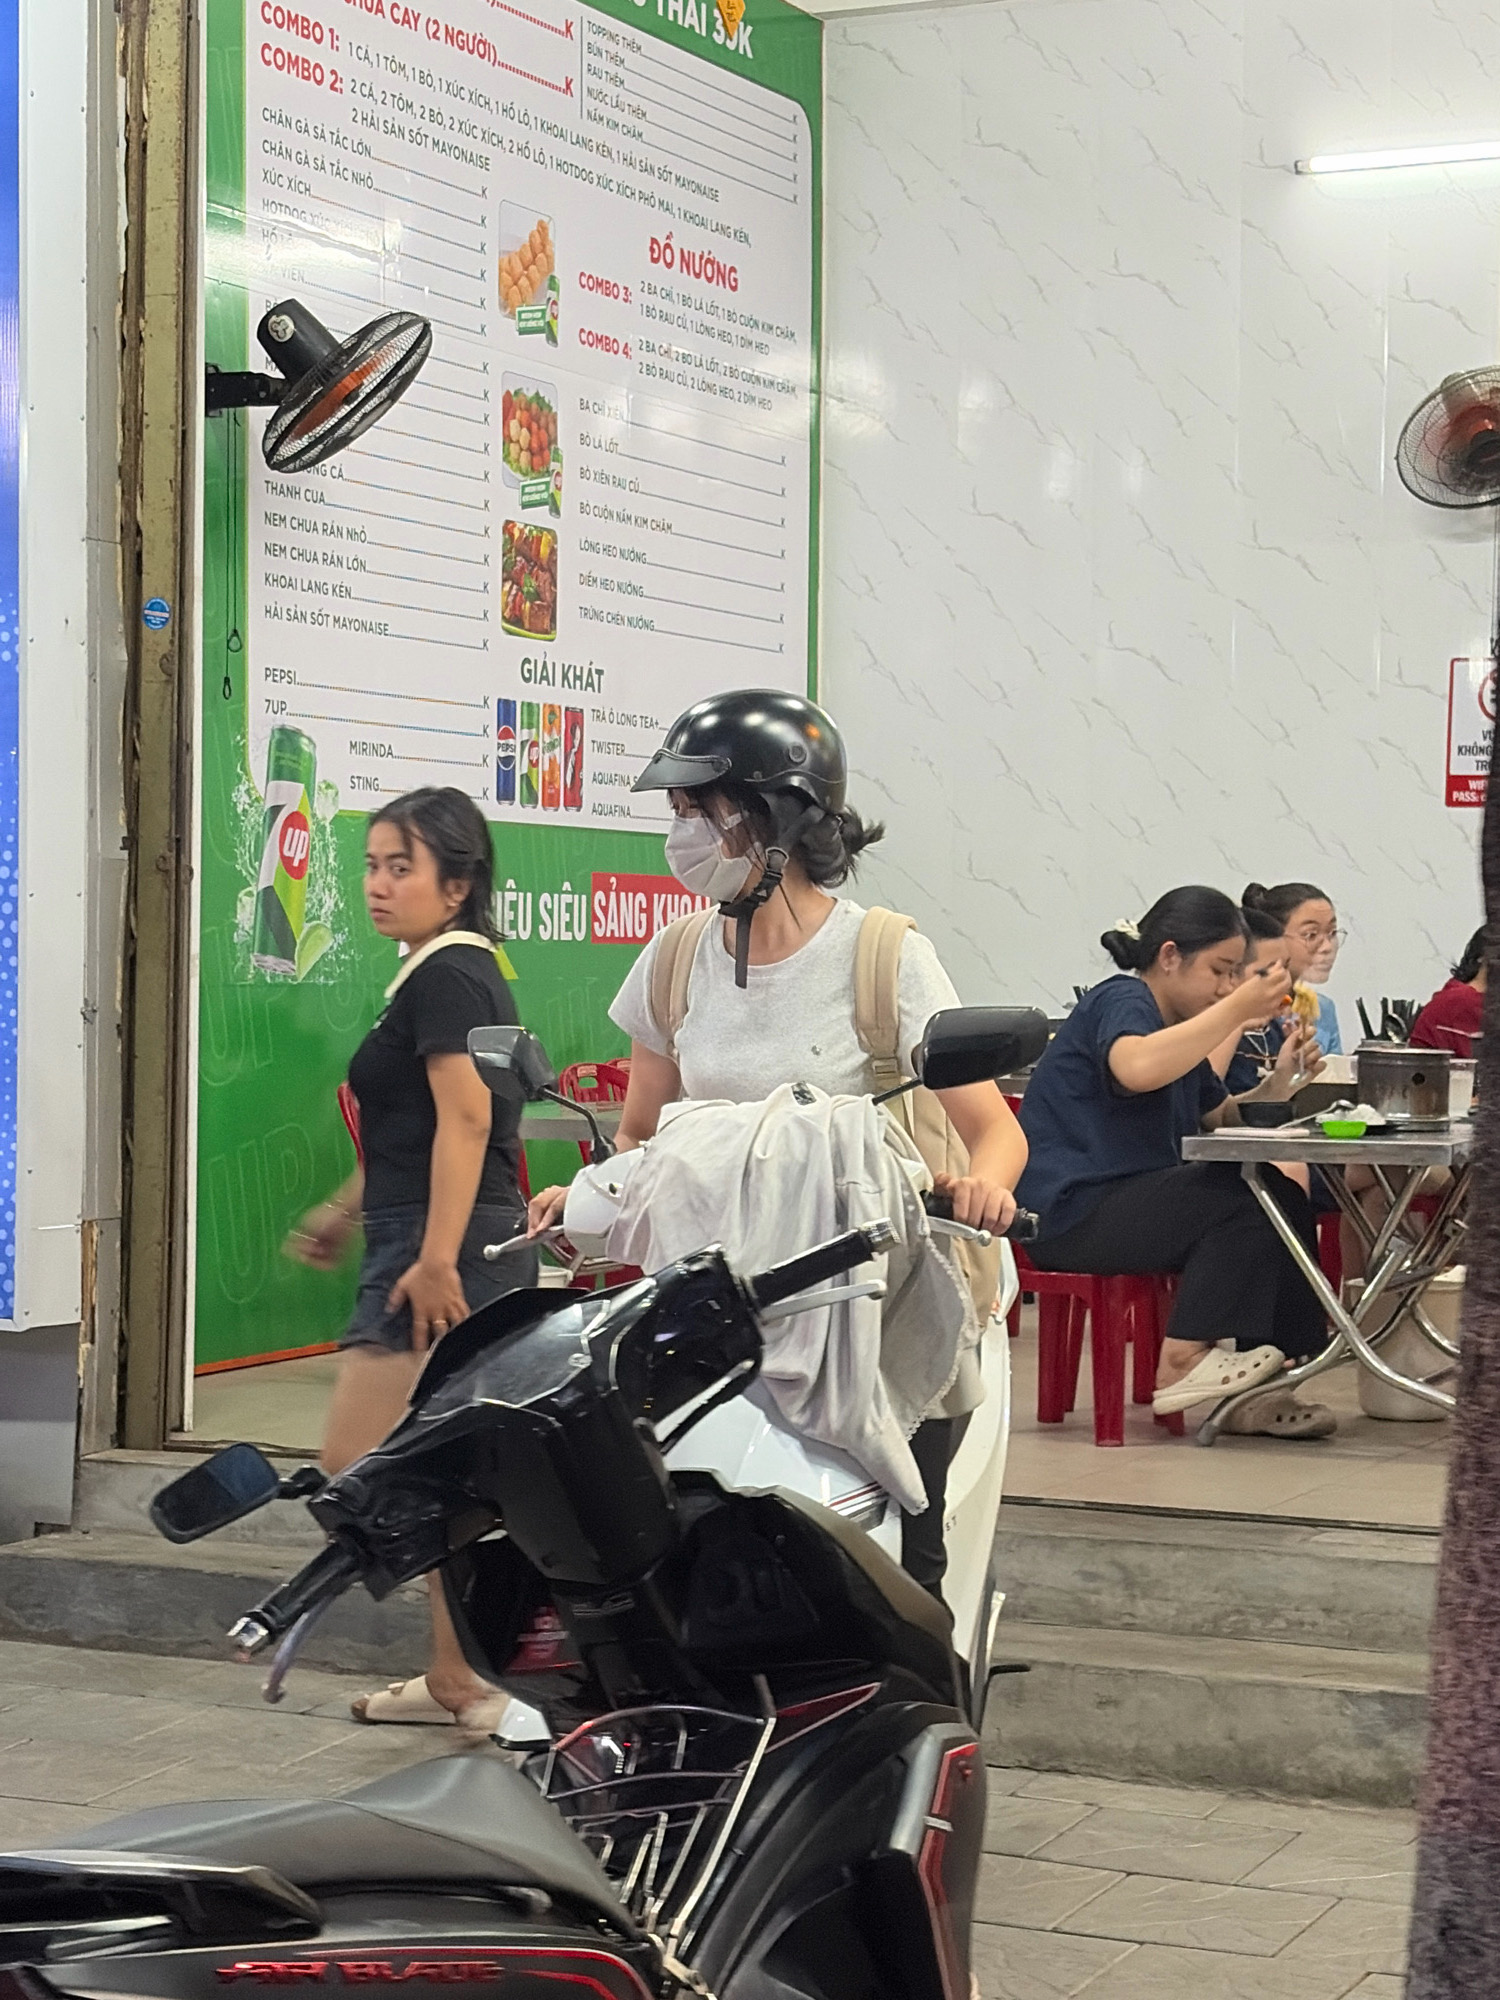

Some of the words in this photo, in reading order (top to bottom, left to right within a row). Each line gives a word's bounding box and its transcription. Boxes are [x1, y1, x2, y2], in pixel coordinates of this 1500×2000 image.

[390, 3, 421, 31] CAY
[587, 20, 620, 45] TOPPING
[587, 63, 603, 79] RAU
[261, 1, 324, 44] COMBO
[328, 28, 339, 52] 1:
[540, 118, 568, 142] KHOAI
[570, 134, 593, 152] LANG
[675, 174, 720, 202] MAYONAISE
[262, 107, 292, 130] CHÂN
[261, 43, 324, 86] COMBO
[329, 69, 343, 94] 2:
[351, 79, 356, 93] 2
[381, 91, 387, 105] 2
[420, 105, 426, 120] 2
[449, 117, 454, 131] 2
[509, 139, 514, 154] 2
[556, 158, 593, 185] HOTDOG
[616, 181, 636, 200] XÍCH
[683, 210, 708, 231] KHOAI
[710, 219, 731, 238] LANG
[262, 139, 292, 162] CHÂN
[352, 108, 358, 123] 2
[432, 137, 491, 172] MAYONAISE
[262, 167, 284, 188] XÚC
[287, 174, 311, 197] XÍCH
[649, 231, 675, 270] ĐỒ
[680, 248, 739, 292] NƯỚNG
[579, 271, 620, 300] COMBO
[623, 286, 632, 304] 3:
[579, 328, 619, 355] COMBO
[622, 342, 632, 360] 4:
[579, 398, 591, 412] BA
[264, 480, 300, 500] THANH
[304, 488, 326, 504] CUA
[612, 476, 627, 491] RAU
[264, 511, 287, 529] NEM
[290, 516, 319, 535] CHUA
[634, 515, 649, 530] KIM
[264, 542, 287, 560] NEM
[290, 547, 319, 564] CHUA
[602, 544, 617, 558] HEO
[264, 572, 297, 591] KHOAI
[301, 578, 328, 596] LANG
[600, 578, 615, 592] HEO
[333, 615, 389, 636] MAYONAISE
[264, 667, 297, 685] PEPSI
[520, 651, 556, 687] GIẢI
[561, 661, 605, 693] KHÁT
[264, 699, 287, 716] 7UP
[616, 713, 637, 728] LONG
[349, 740, 394, 759] MIRINDA
[591, 740, 625, 756] TWISTER
[350, 775, 379, 792] STING
[592, 771, 630, 788] AQUAFINA
[592, 802, 631, 818] AQUAFINA
[539, 881, 587, 941] SIÊU
[593, 877, 647, 938] SẢNG
